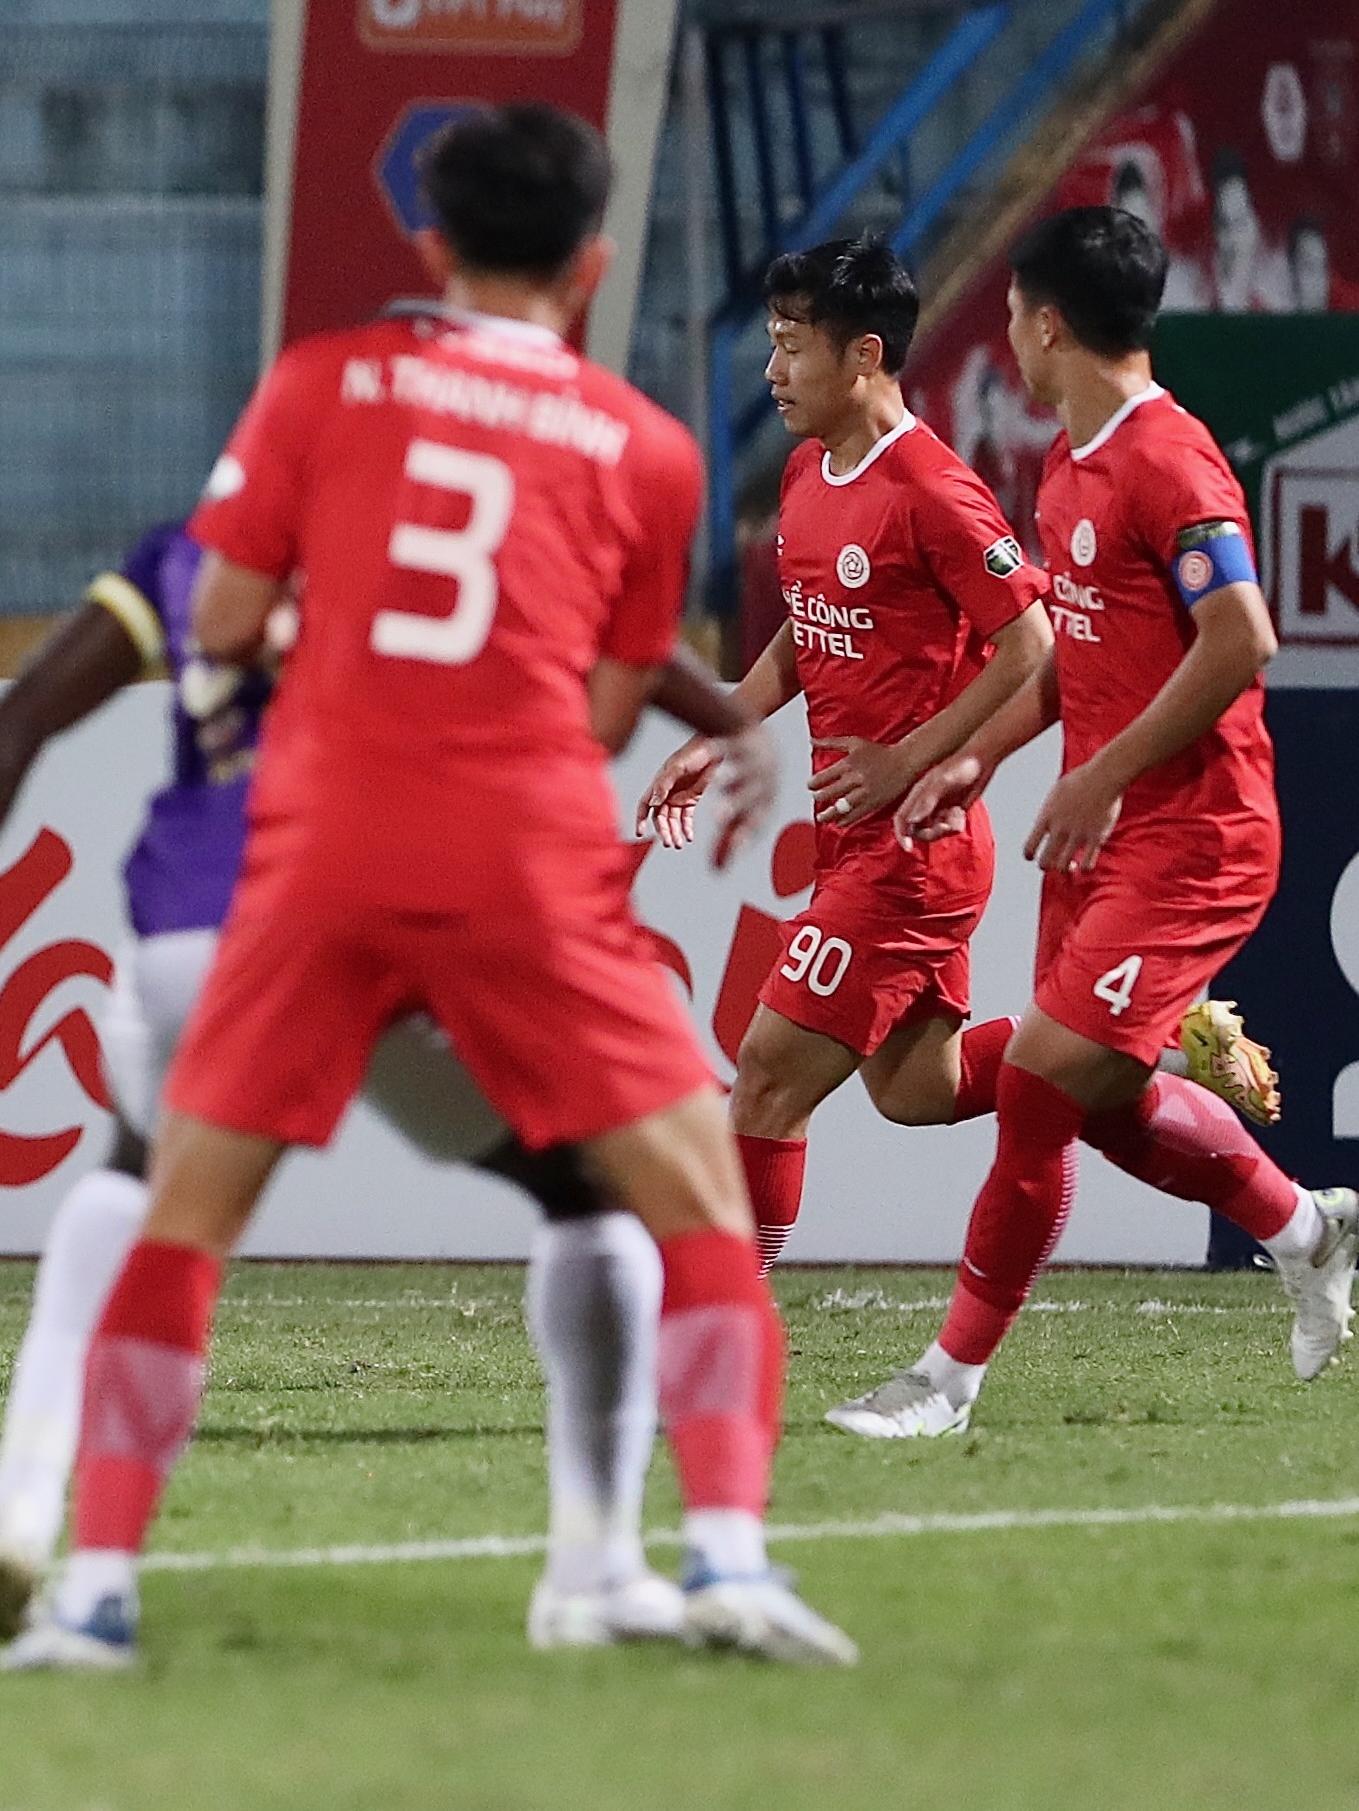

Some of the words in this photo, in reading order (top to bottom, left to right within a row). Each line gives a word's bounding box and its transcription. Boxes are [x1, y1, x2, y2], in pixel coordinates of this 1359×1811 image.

[369, 438, 517, 667] 3
[789, 616, 864, 659] ETTEL
[808, 593, 874, 629] CÔNG
[1048, 605, 1102, 643] TTEL
[779, 925, 853, 997] 90
[1093, 954, 1143, 1017] 4
